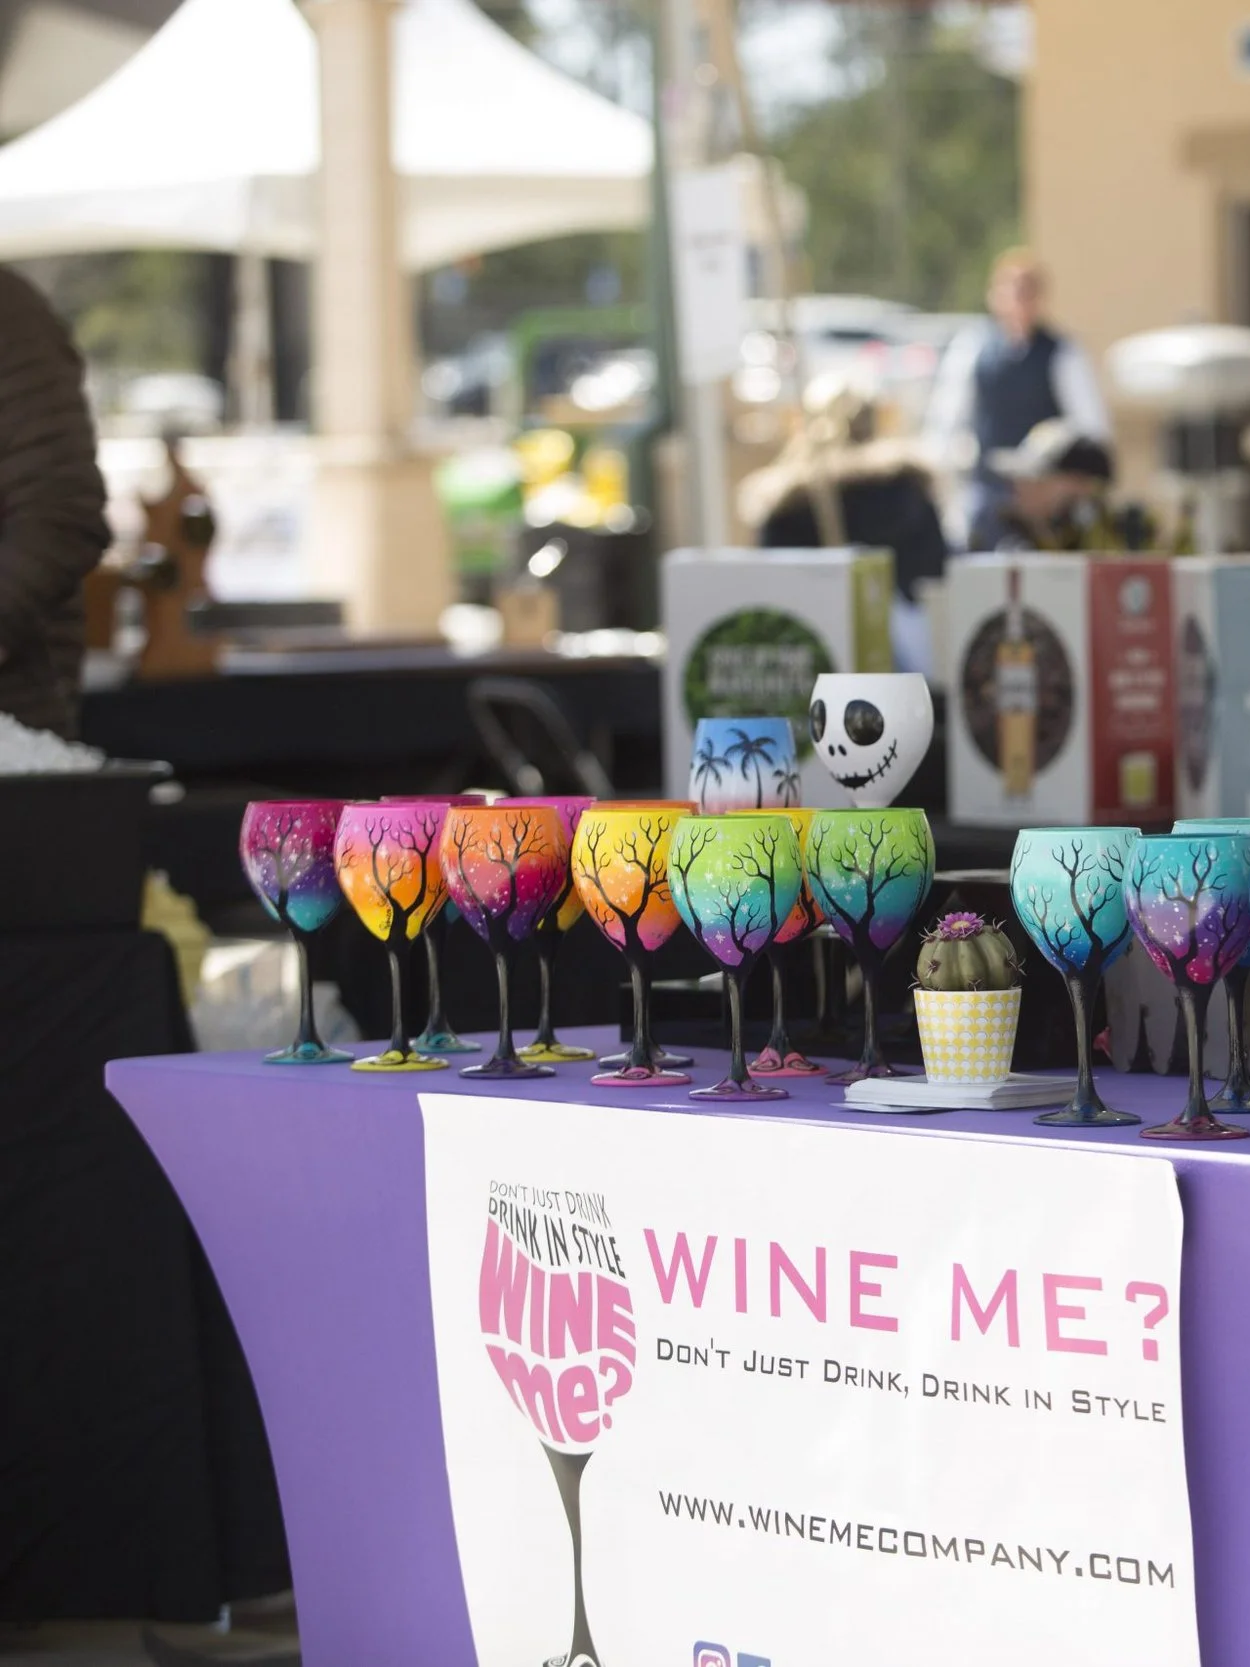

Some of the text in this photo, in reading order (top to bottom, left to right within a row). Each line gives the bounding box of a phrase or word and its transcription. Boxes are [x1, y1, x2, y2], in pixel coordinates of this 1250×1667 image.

[488, 1196, 627, 1280] DRINK IN STYLE
[531, 1186, 561, 1212] JUST
[564, 1190, 612, 1230] DRINK
[478, 1215, 637, 1369] WINE
[643, 1228, 1169, 1361] WINE ME?
[484, 1343, 633, 1445] me?
